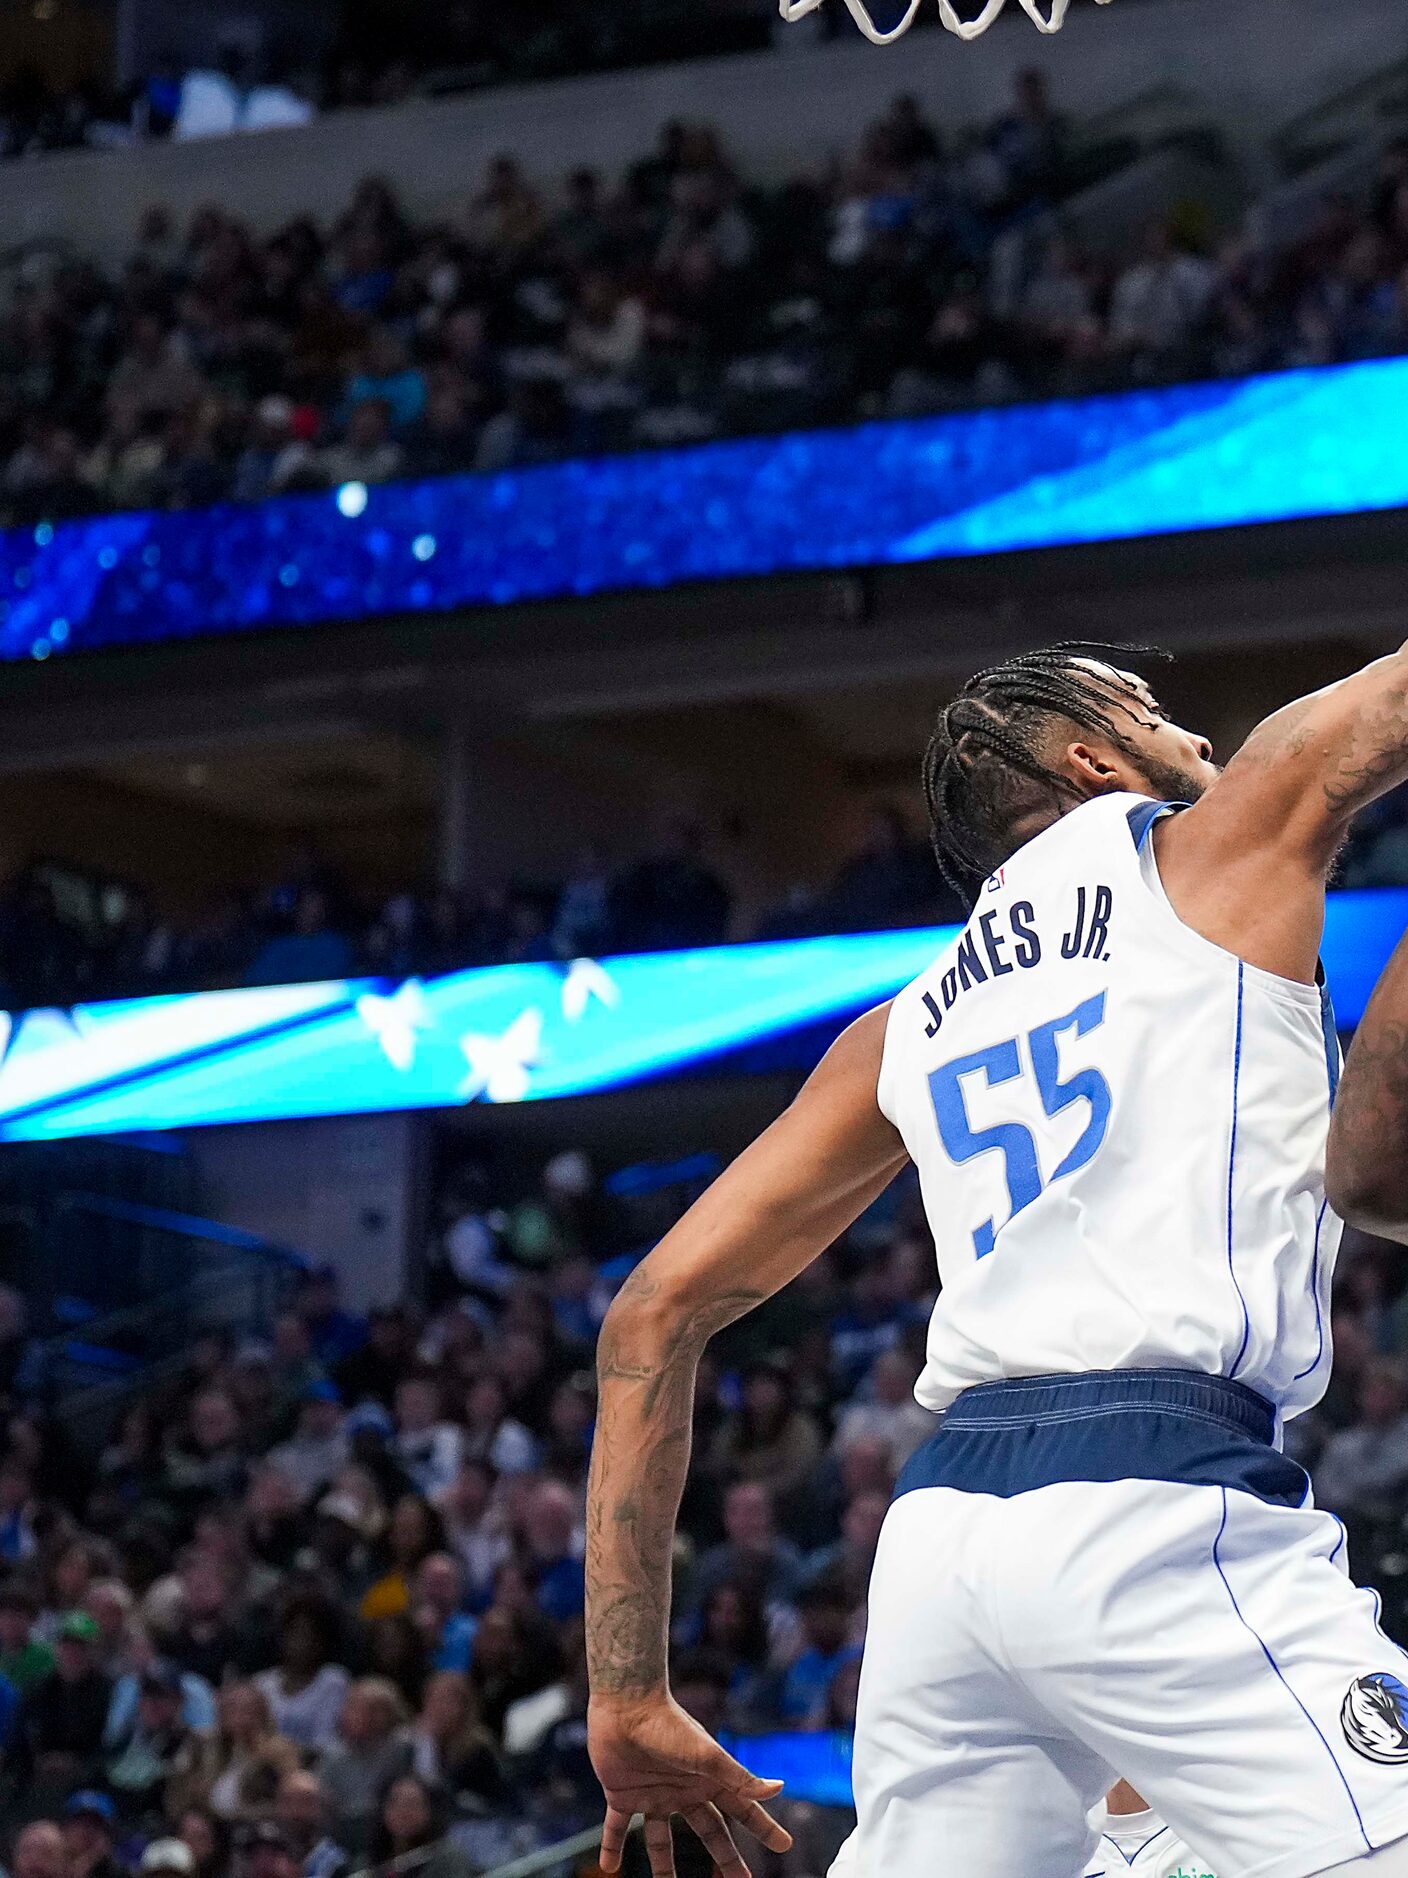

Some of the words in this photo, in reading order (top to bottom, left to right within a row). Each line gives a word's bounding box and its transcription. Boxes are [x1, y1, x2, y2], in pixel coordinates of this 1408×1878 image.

[920, 900, 1042, 1038] JONES
[1060, 885, 1112, 962] JR.
[926, 987, 1113, 1261] 55
